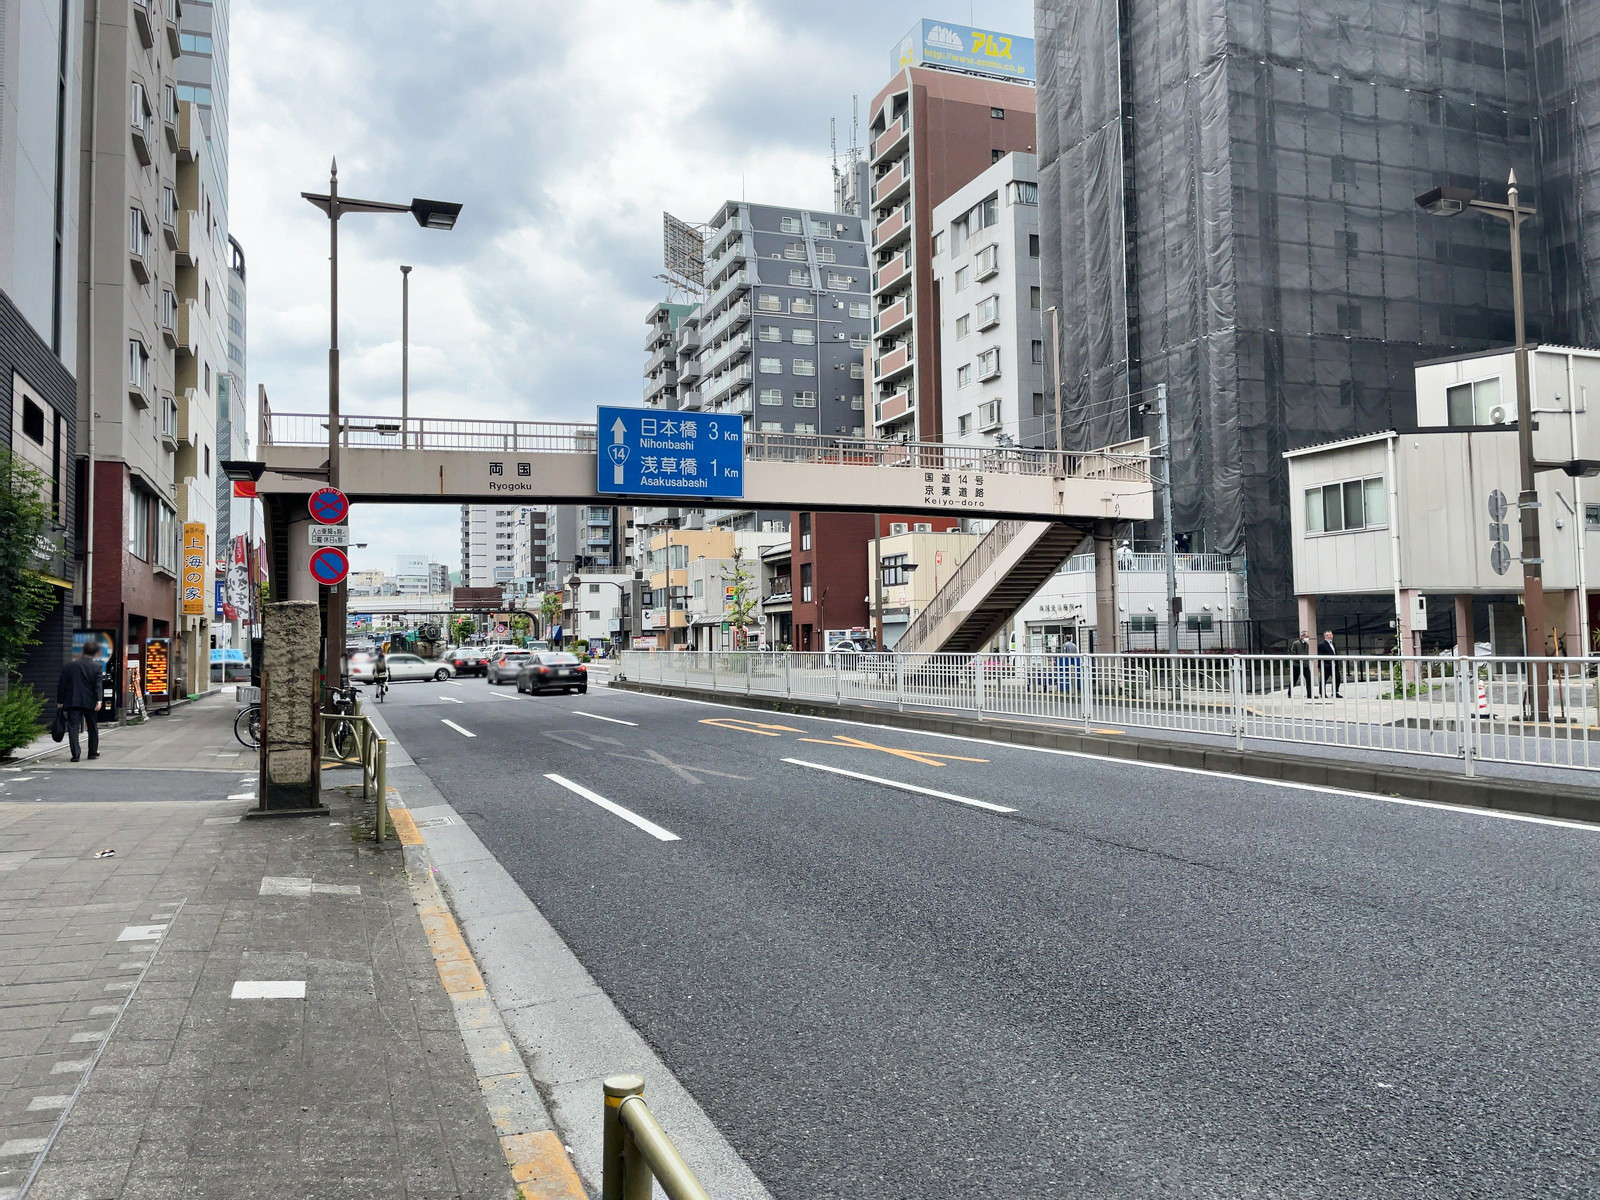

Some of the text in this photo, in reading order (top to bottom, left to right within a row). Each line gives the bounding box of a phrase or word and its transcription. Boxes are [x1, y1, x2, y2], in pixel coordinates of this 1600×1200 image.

[971, 31, 1013, 60] アムス
[641, 418, 739, 441] 日本橋 3 Km
[640, 438, 694, 451] Nihonbashi
[612, 447, 626, 460] 14
[489, 462, 531, 476] 両国
[640, 455, 739, 478] 浅草橋 1 Km
[640, 475, 708, 488] Asakusabashi
[924, 472, 985, 486] 国道14号
[489, 481, 532, 492] Ryogoku
[924, 485, 985, 498] 京葉道路
[924, 497, 985, 507] Keiyo-doro
[185, 537, 204, 601] 上海の家
